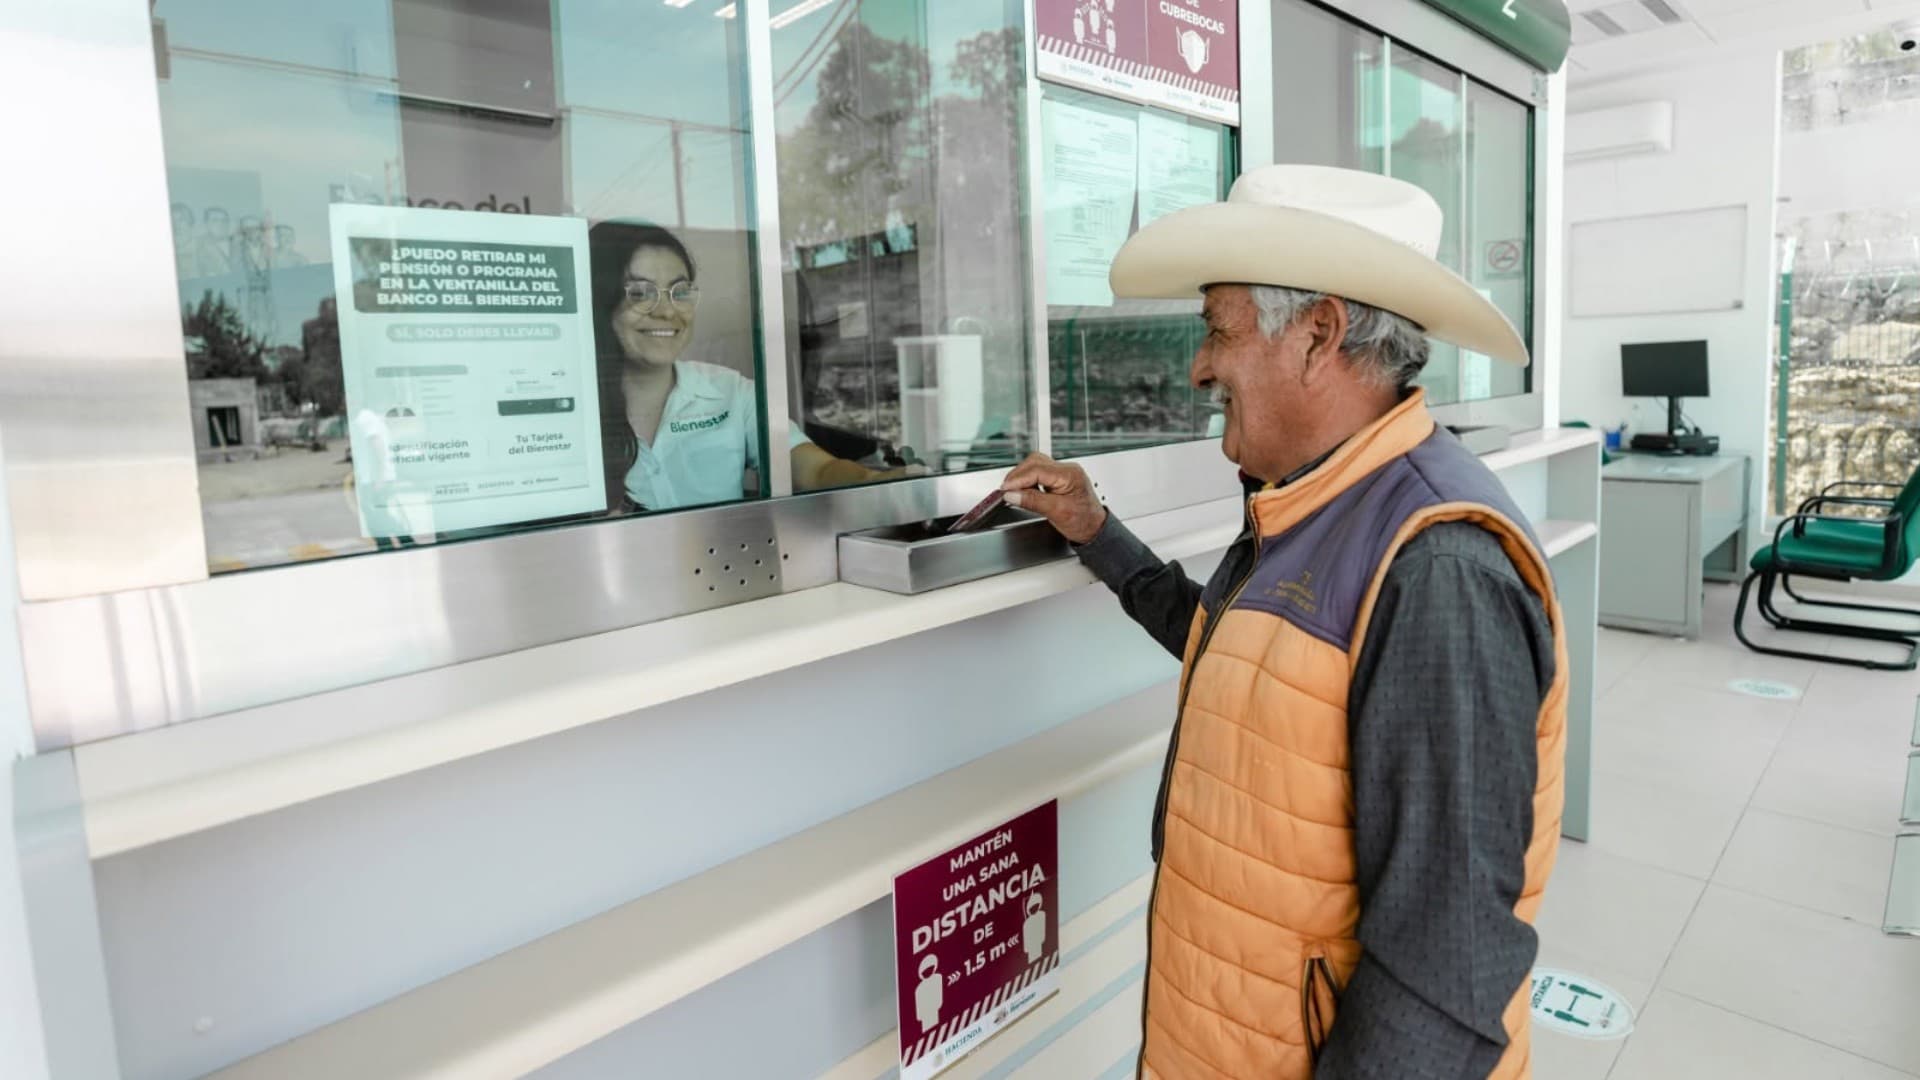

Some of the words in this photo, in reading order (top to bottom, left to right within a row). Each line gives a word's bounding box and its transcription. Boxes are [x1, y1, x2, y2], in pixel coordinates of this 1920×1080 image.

[1160, 1, 1225, 34] CUBREBOCAS
[392, 247, 457, 262] ¿PUEDO
[461, 250, 526, 263] RETIRAR
[528, 253, 546, 264] MI
[379, 260, 452, 276] PENSIÓN
[456, 265, 469, 276] O
[473, 266, 557, 278] PROGRAMA
[380, 277, 404, 290] EN
[408, 278, 430, 290] LA
[433, 279, 529, 292] VENTANILLA
[531, 281, 560, 293] DEL
[377, 292, 438, 305] BANCO
[442, 294, 473, 306] DEL
[476, 294, 564, 307] BIENESTAR?
[416, 328, 453, 338] SOLO
[457, 327, 500, 338] DEBES
[670, 410, 729, 433] Bienestar
[508, 445, 524, 456] del
[526, 442, 572, 454] Bienestar
[516, 434, 529, 444] Tu
[428, 451, 471, 463] vigente
[950, 829, 1013, 873] MANTÉN
[943, 875, 976, 901] UNA
[979, 851, 1019, 882] SANA
[912, 863, 1046, 955] DISTANCIA
[973, 921, 994, 944] DE
[964, 951, 986, 976] 1.5
[990, 942, 1006, 962] m
[944, 1027, 983, 1056] HACIENDA
